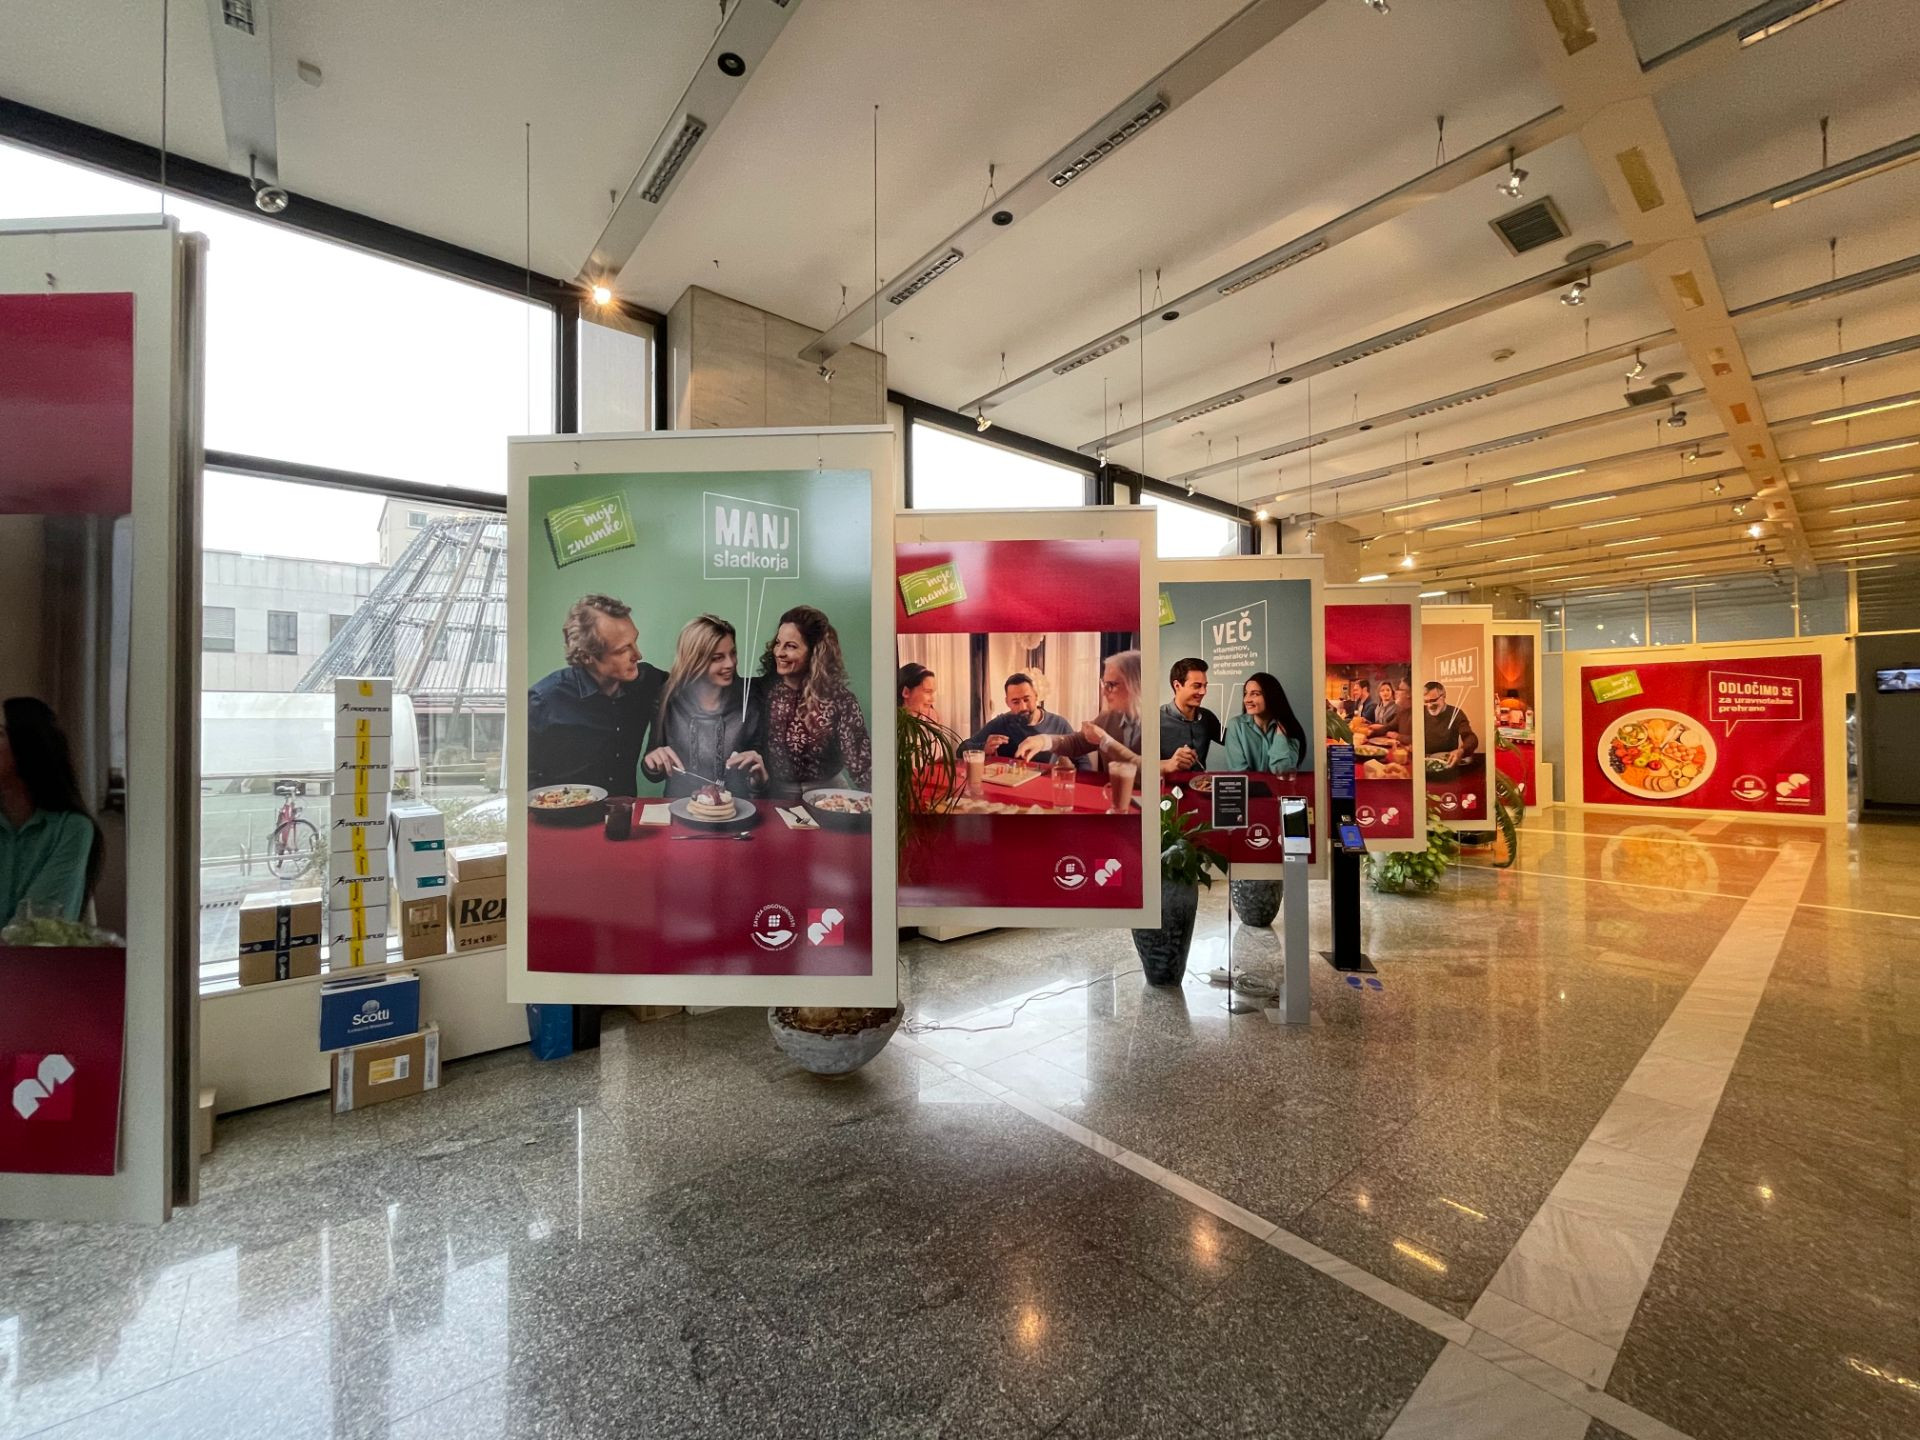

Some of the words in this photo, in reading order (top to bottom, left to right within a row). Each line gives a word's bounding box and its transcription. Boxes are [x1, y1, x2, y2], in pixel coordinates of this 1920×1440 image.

[583, 503, 617, 527] moje
[567, 520, 623, 555] znamke
[715, 505, 789, 550] MANJ
[713, 549, 789, 572] sladkorja
[926, 570, 953, 587] moje
[915, 582, 957, 608] znamke
[1212, 610, 1252, 646] VEČ
[1440, 655, 1473, 676] MANJ
[1718, 681, 1779, 696] ODLOČIMO
[1782, 686, 1793, 697] SE
[352, 1008, 390, 1026] Scotti
